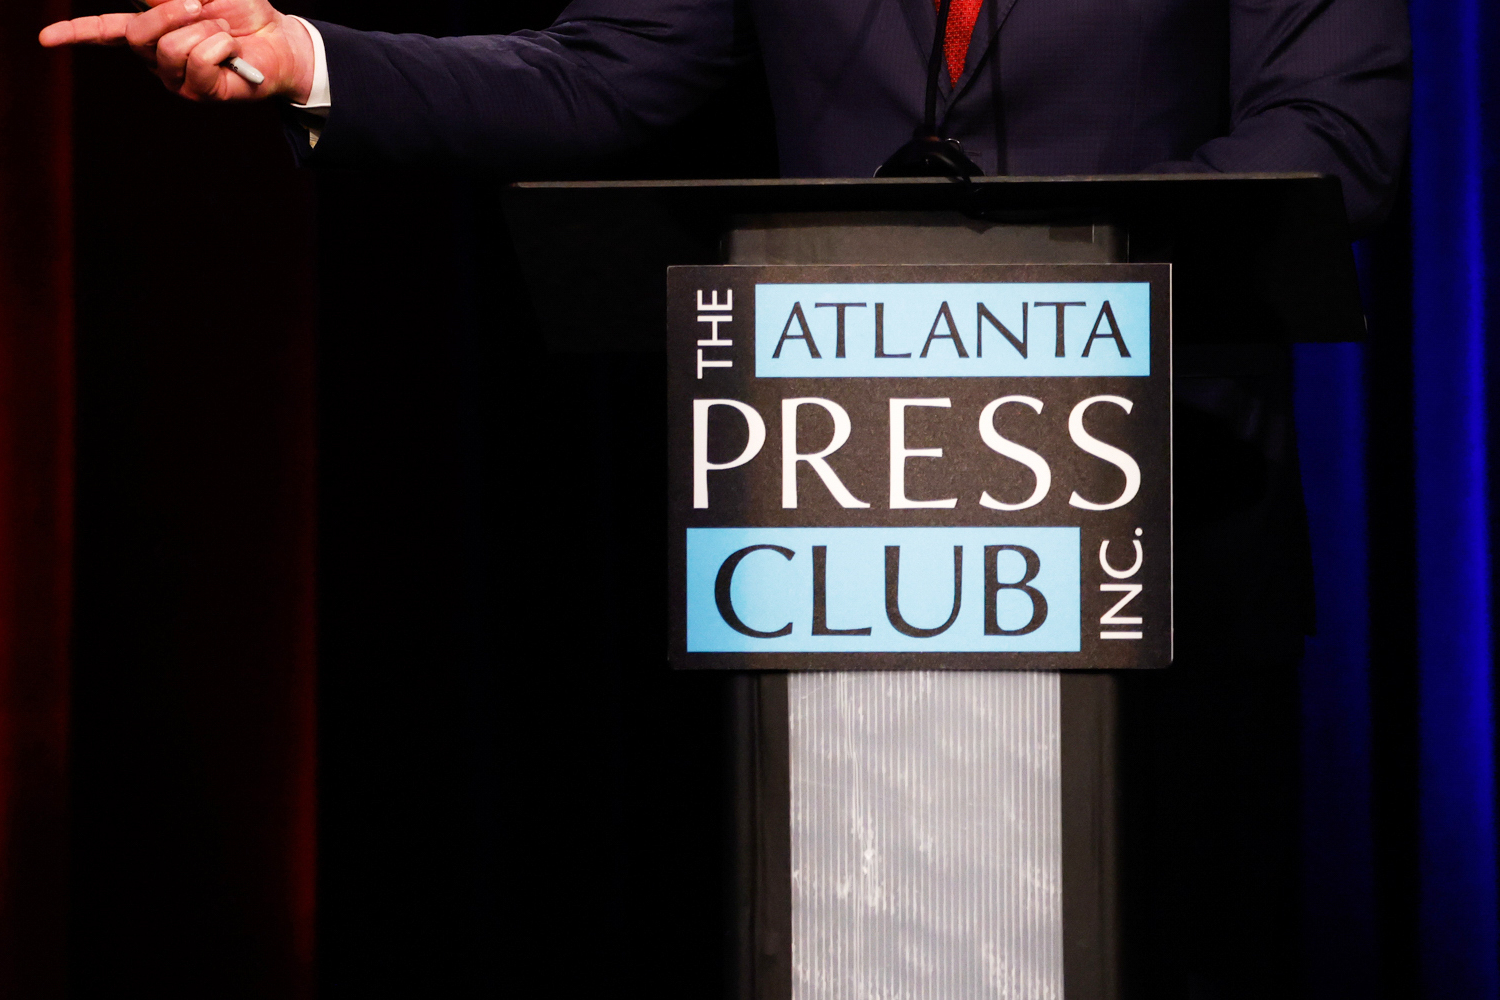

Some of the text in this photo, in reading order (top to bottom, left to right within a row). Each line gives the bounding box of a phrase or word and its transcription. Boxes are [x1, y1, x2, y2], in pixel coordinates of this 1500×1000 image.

[696, 288, 733, 380] THE
[771, 299, 1132, 360] ATLANTA
[692, 394, 1141, 512] PRESS
[713, 543, 1049, 639] CLUB
[1098, 527, 1143, 640] INC.
